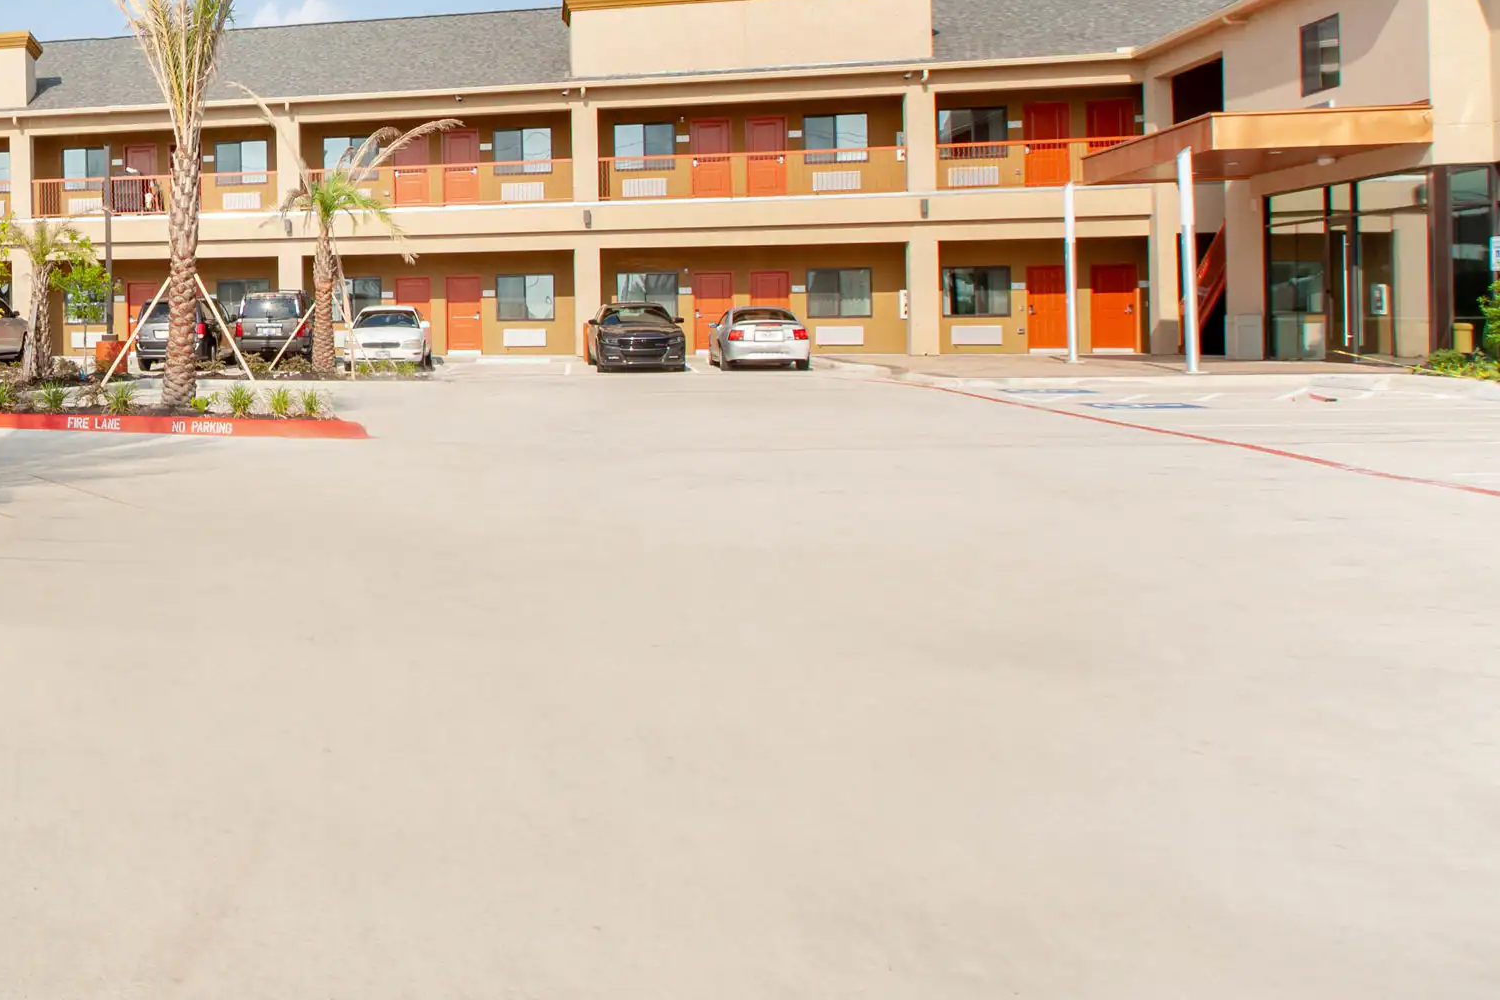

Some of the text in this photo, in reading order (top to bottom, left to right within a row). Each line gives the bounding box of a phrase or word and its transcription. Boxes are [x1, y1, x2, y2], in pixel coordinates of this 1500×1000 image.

[67, 416, 121, 430] FIRE LANE
[171, 420, 233, 435] NO PARKING
